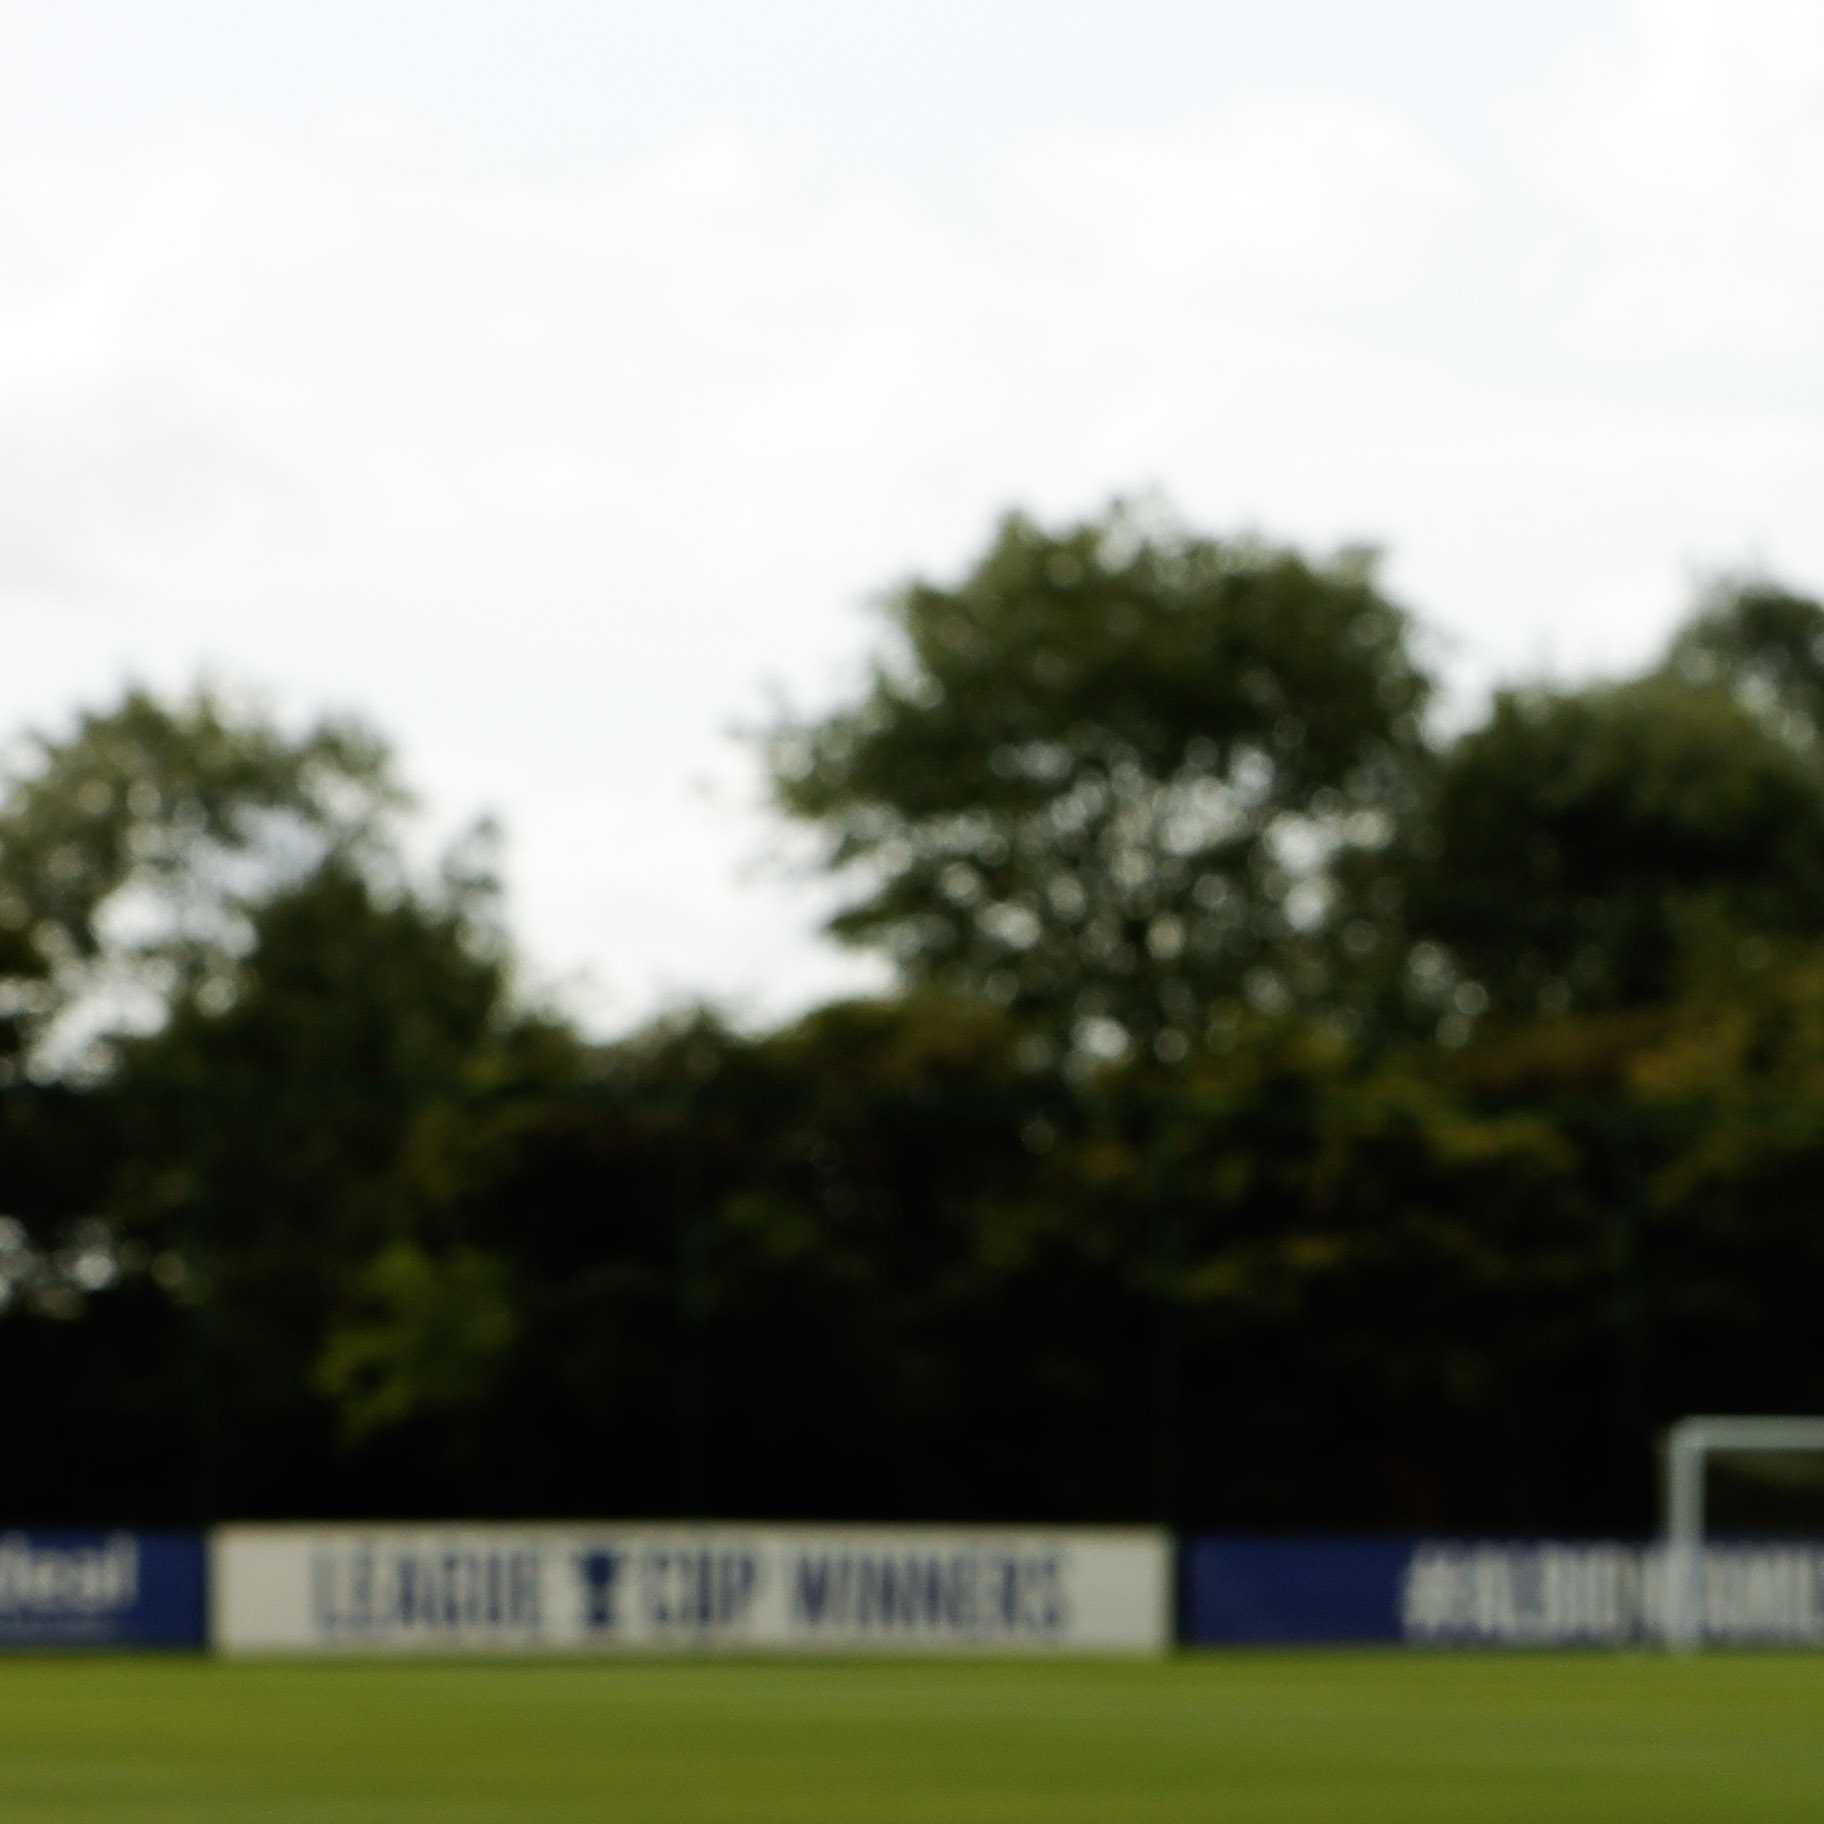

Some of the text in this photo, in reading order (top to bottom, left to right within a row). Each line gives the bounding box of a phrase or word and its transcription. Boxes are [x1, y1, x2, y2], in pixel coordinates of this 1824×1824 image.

[311, 1546, 1068, 1634] LEAGUE CUP WINNERS
